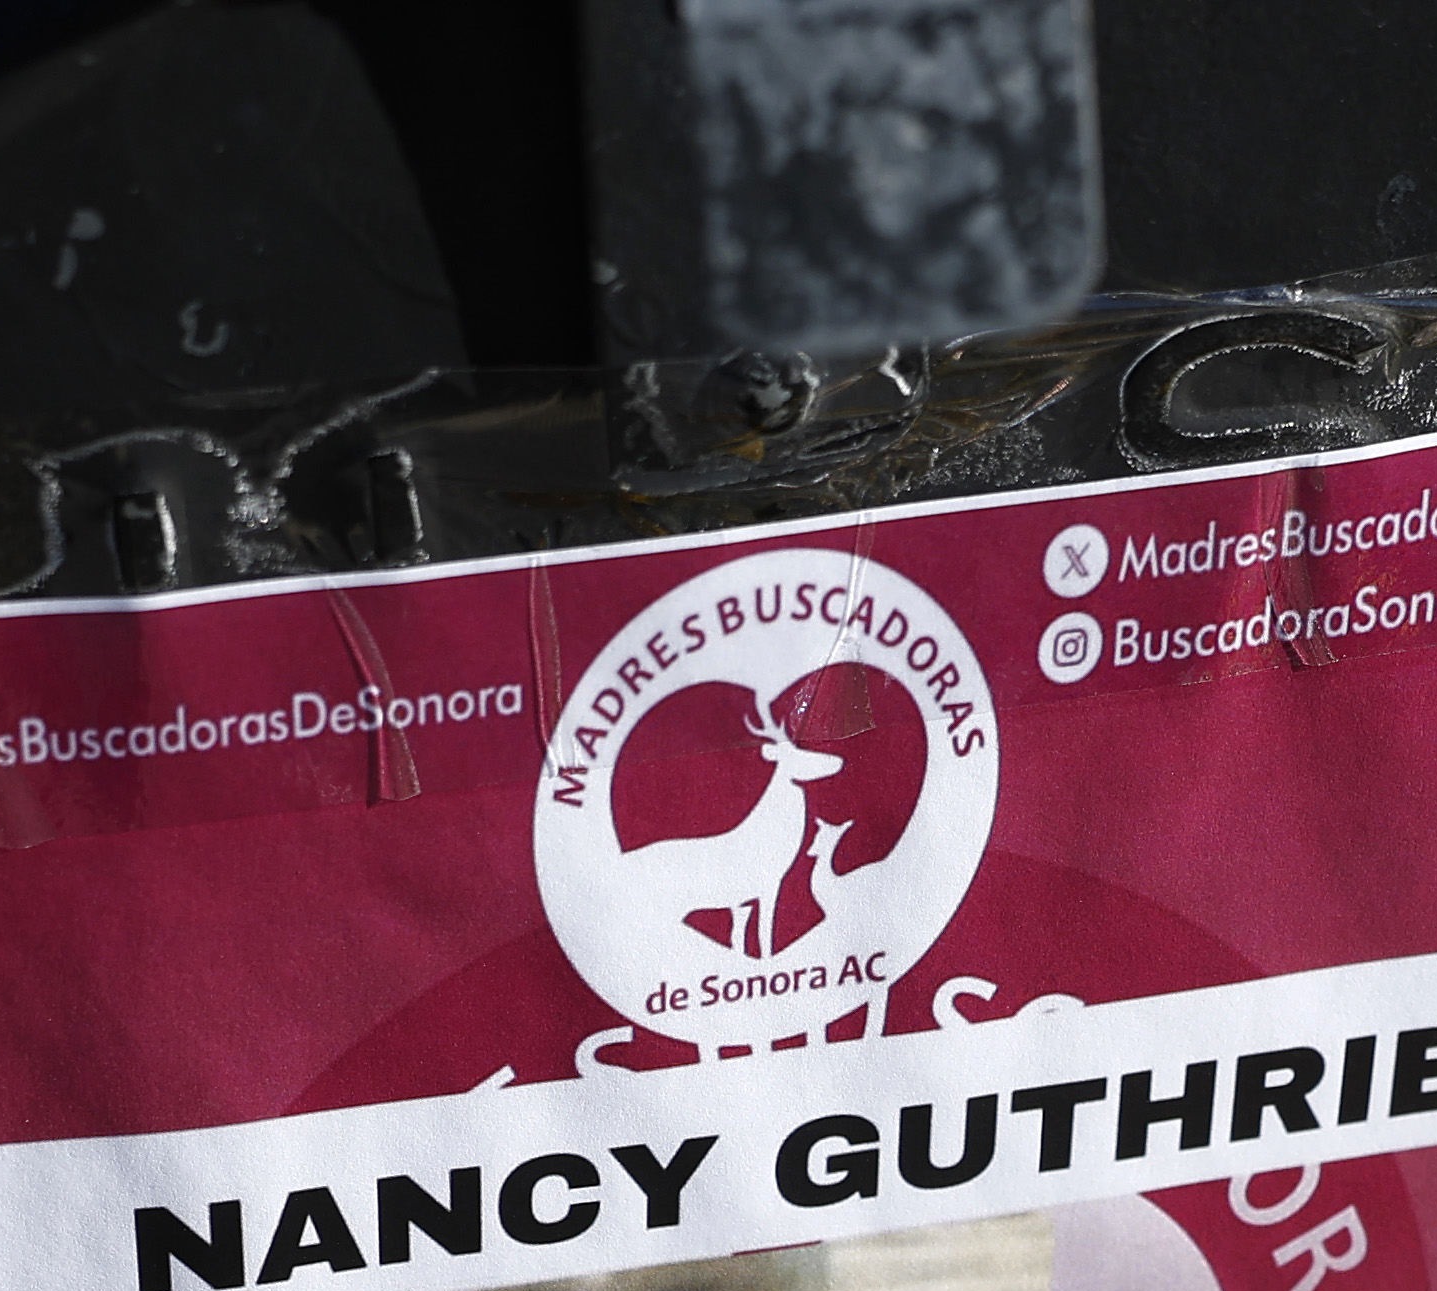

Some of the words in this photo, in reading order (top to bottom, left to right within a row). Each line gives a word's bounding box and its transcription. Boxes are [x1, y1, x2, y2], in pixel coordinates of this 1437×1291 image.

[553, 613, 706, 809] MADRES
[715, 582, 985, 760] BUSCADORAS
[645, 981, 689, 1014] de
[699, 962, 828, 1008] Sonora
[836, 950, 887, 988] AC
